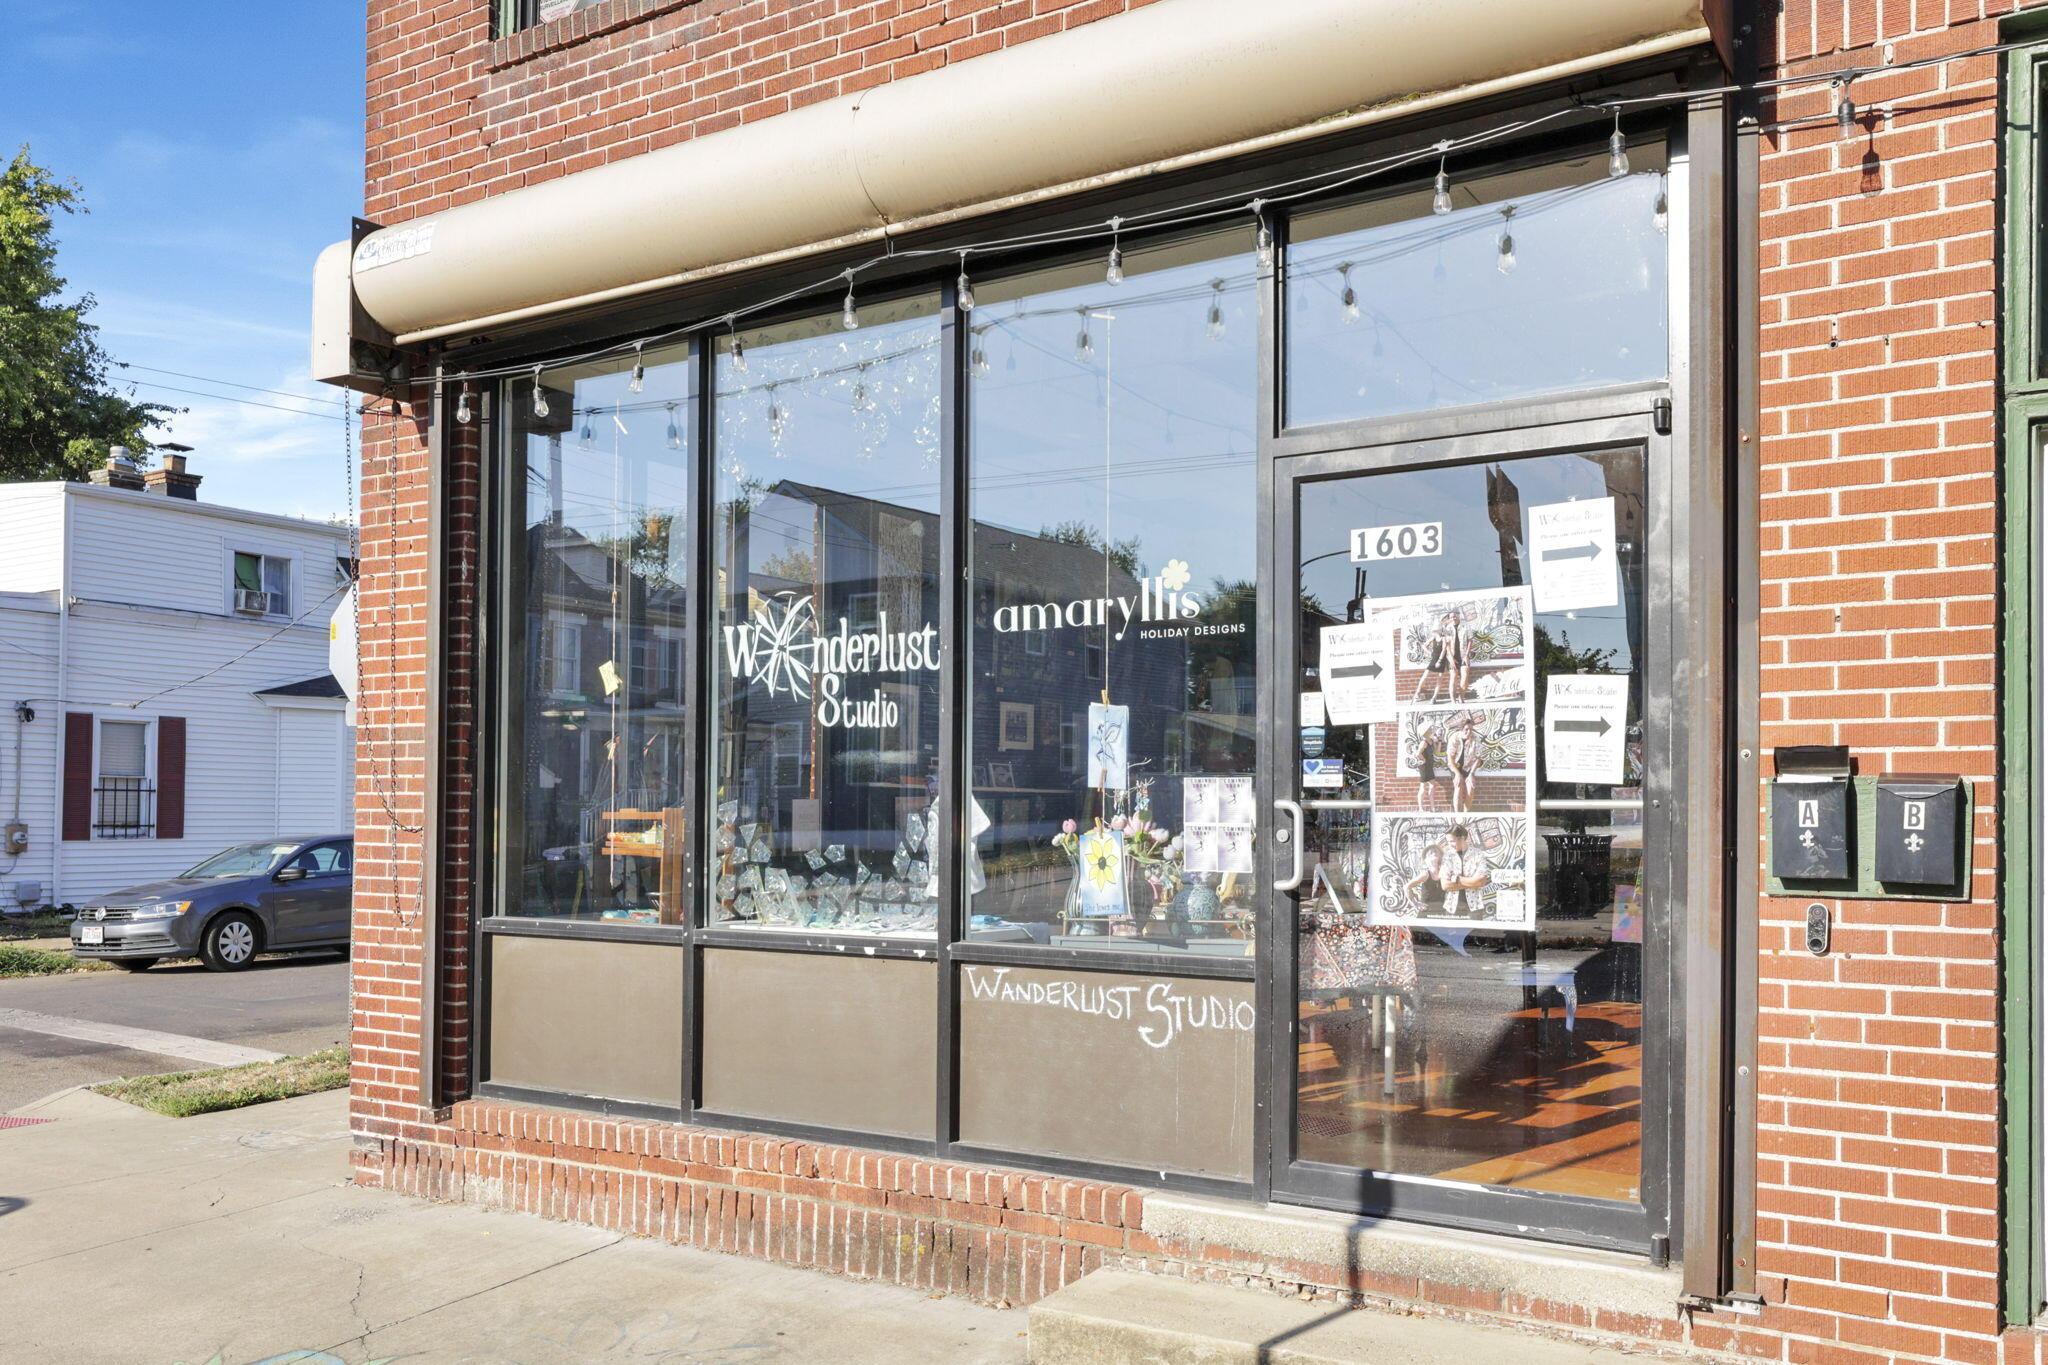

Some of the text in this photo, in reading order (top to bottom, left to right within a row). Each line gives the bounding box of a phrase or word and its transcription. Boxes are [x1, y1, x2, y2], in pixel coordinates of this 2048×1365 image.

[1357, 525, 1439, 560] 1603
[993, 559, 1201, 641] amaryllis
[1140, 622, 1246, 640] HOLIDAY DESIGNS
[817, 672, 899, 729] Studio
[1801, 801, 1815, 825] A
[1908, 804, 1921, 828] B
[964, 967, 1256, 1048] WANDERLUST STUDIO
